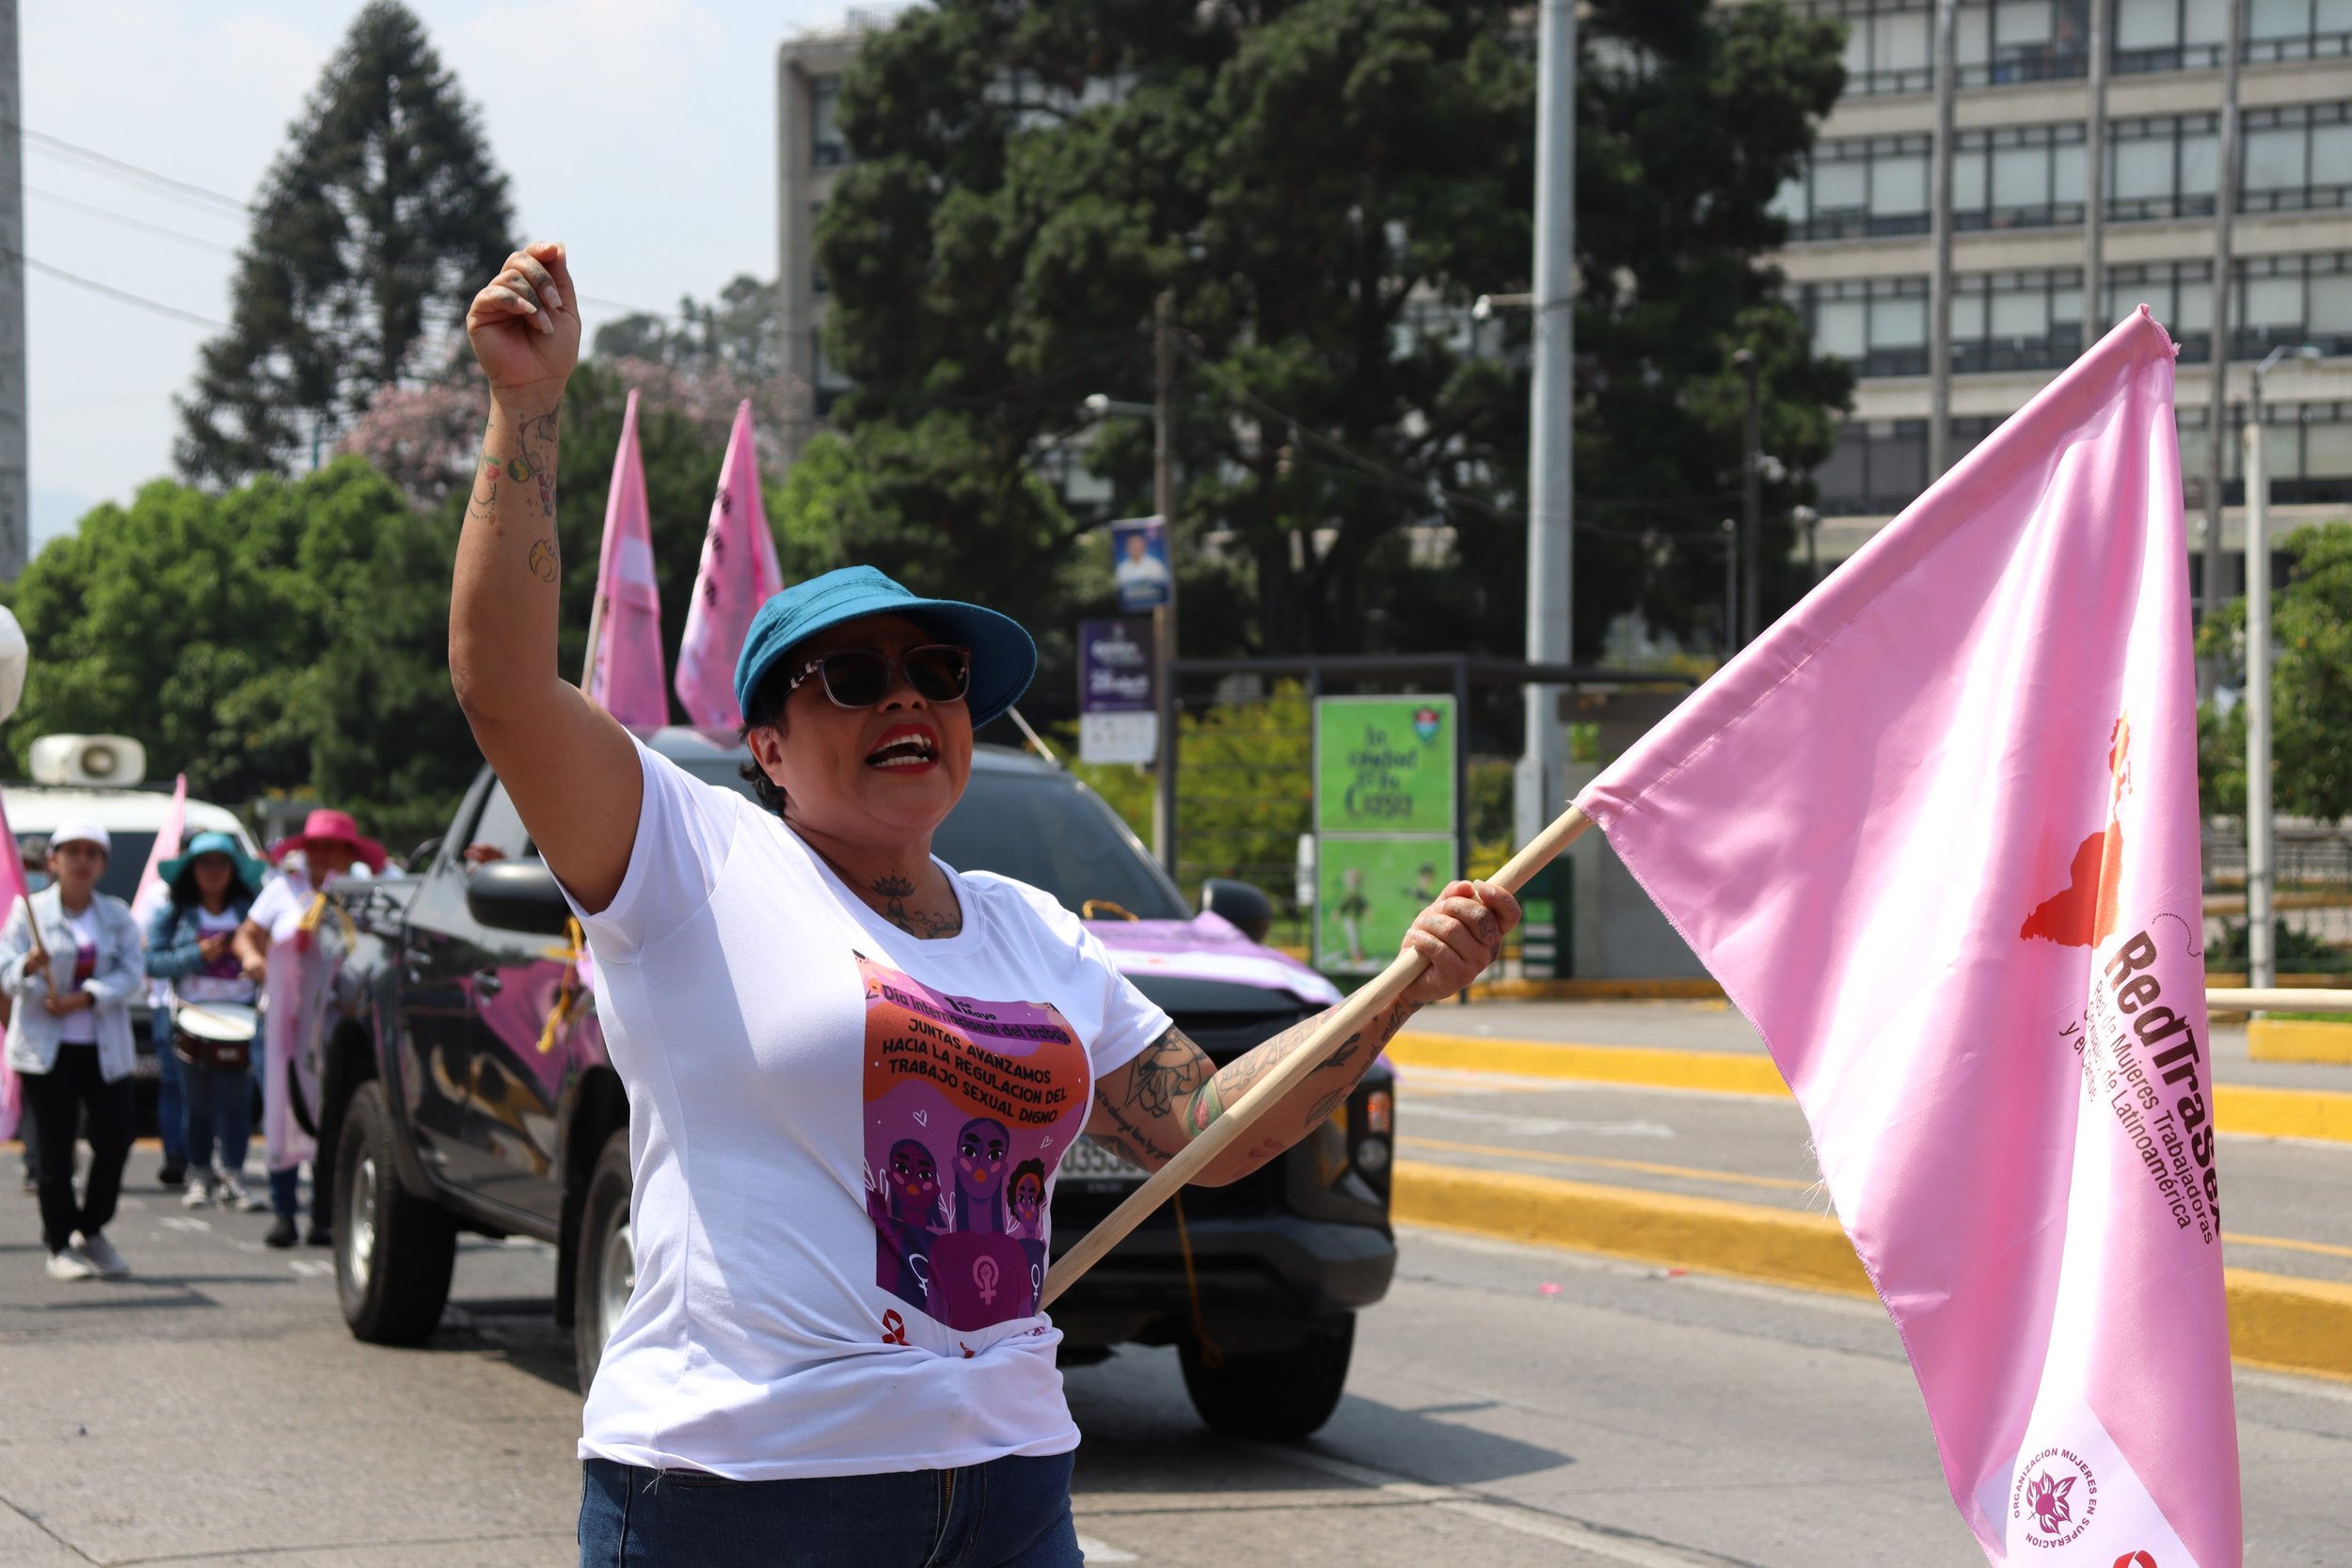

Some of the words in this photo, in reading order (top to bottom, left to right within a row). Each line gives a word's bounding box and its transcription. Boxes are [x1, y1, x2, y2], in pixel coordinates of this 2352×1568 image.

[908, 1018, 961, 1051] JUNTAS
[966, 1044, 1052, 1085] AVANZAMOS
[1001, 1024, 1025, 1037] del
[2058, 1021, 2080, 1037] y
[2074, 1036, 2089, 1055] el
[882, 1037, 929, 1054] HACIA
[932, 1043, 950, 1064] LA
[955, 1055, 1042, 1104] REGULACION
[1045, 1086, 1068, 1104] DEL
[888, 1059, 958, 1088] TRABAJO
[962, 1083, 1014, 1117] SEXUAL
[2111, 1033, 2159, 1111] Mujeres
[2153, 1109, 2213, 1244] Trabajadoras
[2111, 1089, 2191, 1229] Latinoamérica
[2013, 1448, 2058, 1518] ORGANIZACION
[2060, 1449, 2097, 1495] MUJERES
[2026, 1517, 2090, 1548] SUPERACION
[2087, 1498, 2097, 1515] EN
